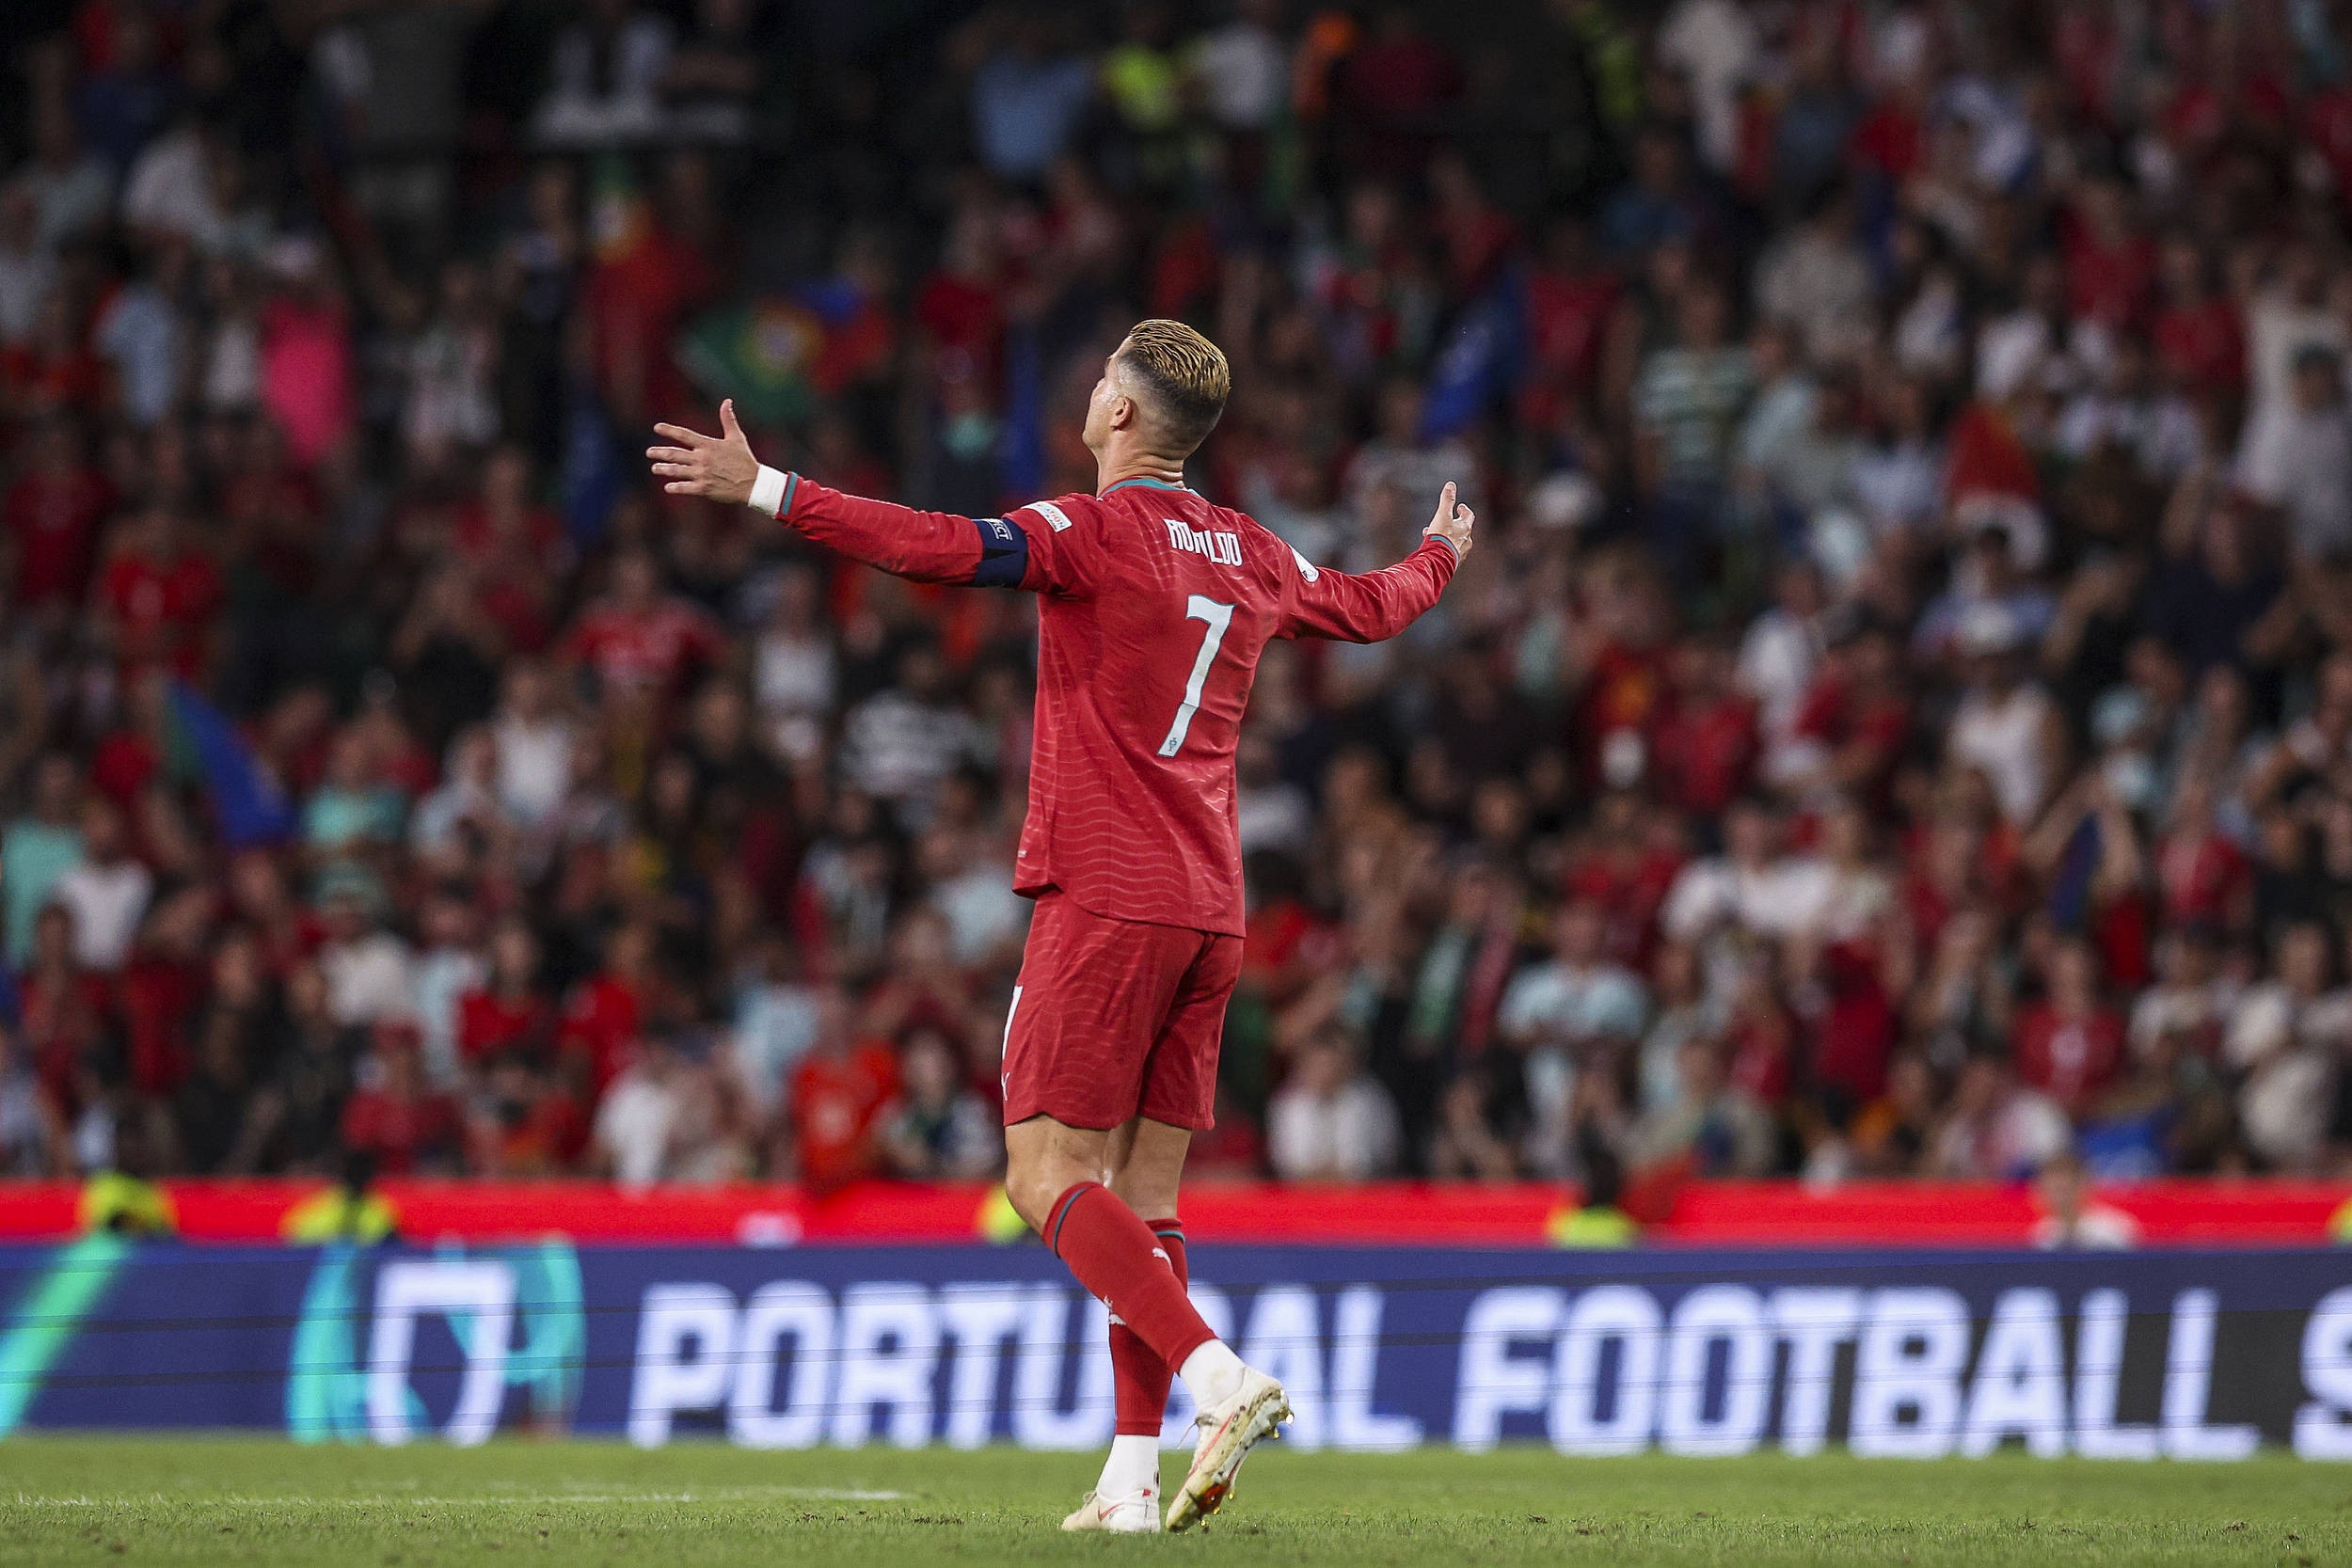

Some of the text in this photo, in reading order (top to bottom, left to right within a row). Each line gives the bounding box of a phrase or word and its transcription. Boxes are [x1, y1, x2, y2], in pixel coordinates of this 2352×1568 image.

[1163, 518, 1243, 566] RONLDO
[1157, 594, 1236, 757] 7
[627, 1281, 1423, 1451] PORTUAL
[1454, 1284, 2261, 1462] FOOTBALL
